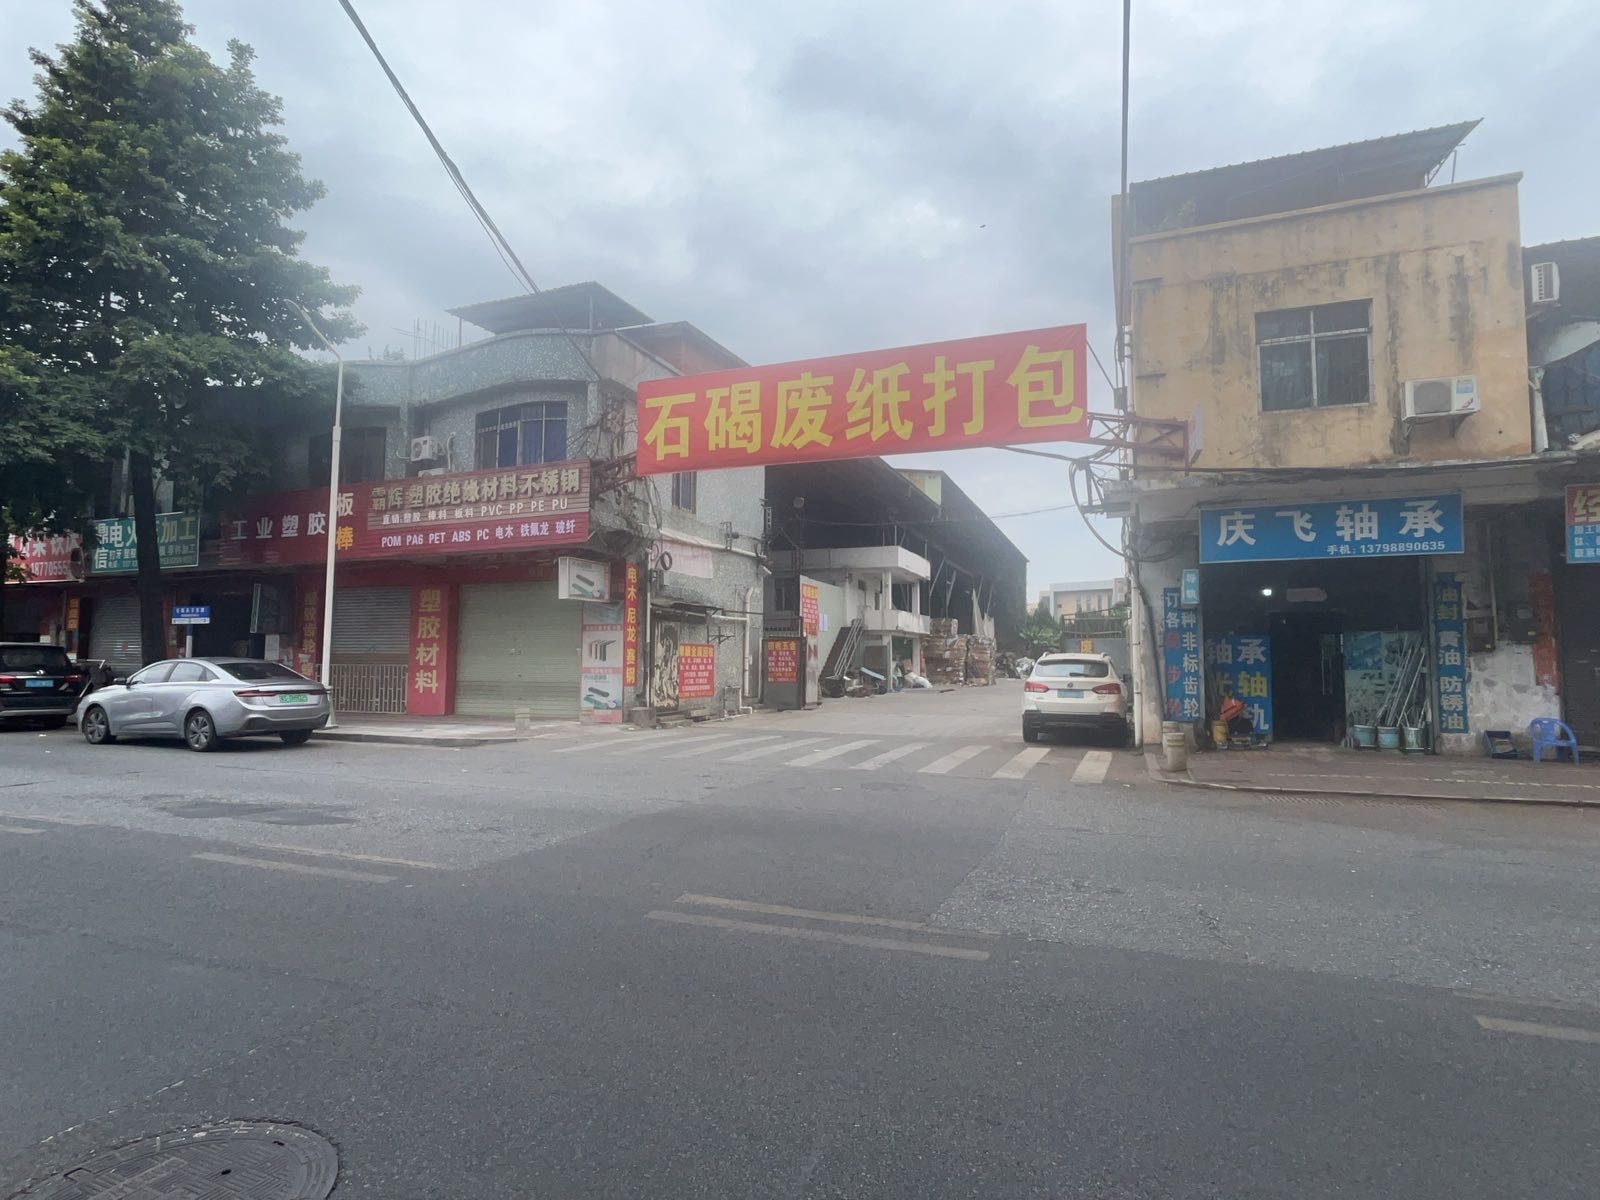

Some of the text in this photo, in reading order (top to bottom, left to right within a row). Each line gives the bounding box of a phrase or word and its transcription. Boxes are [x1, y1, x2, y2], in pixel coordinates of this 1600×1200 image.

[643, 344, 1085, 462] 石碣废纸打包
[481, 504, 503, 517] PVC
[510, 502, 524, 514] PP
[531, 500, 545, 512] PE
[552, 498, 568, 511] PU
[1216, 499, 1446, 547] 庆飞轴承
[1574, 488, 1600, 523] 经
[381, 536, 402, 548] POM
[406, 534, 424, 546] PA6
[429, 532, 446, 544] PET
[452, 530, 471, 543] ABS
[477, 528, 490, 541] PC
[495, 525, 514, 540] 电木
[627, 567, 637, 602] 电木
[415, 589, 441, 694] 塑胶材料
[626, 608, 637, 642] 尼龙
[1206, 638, 1267, 665] 轴承
[1438, 630, 1462, 667] 黄油
[1440, 676, 1465, 730] 防锈油
